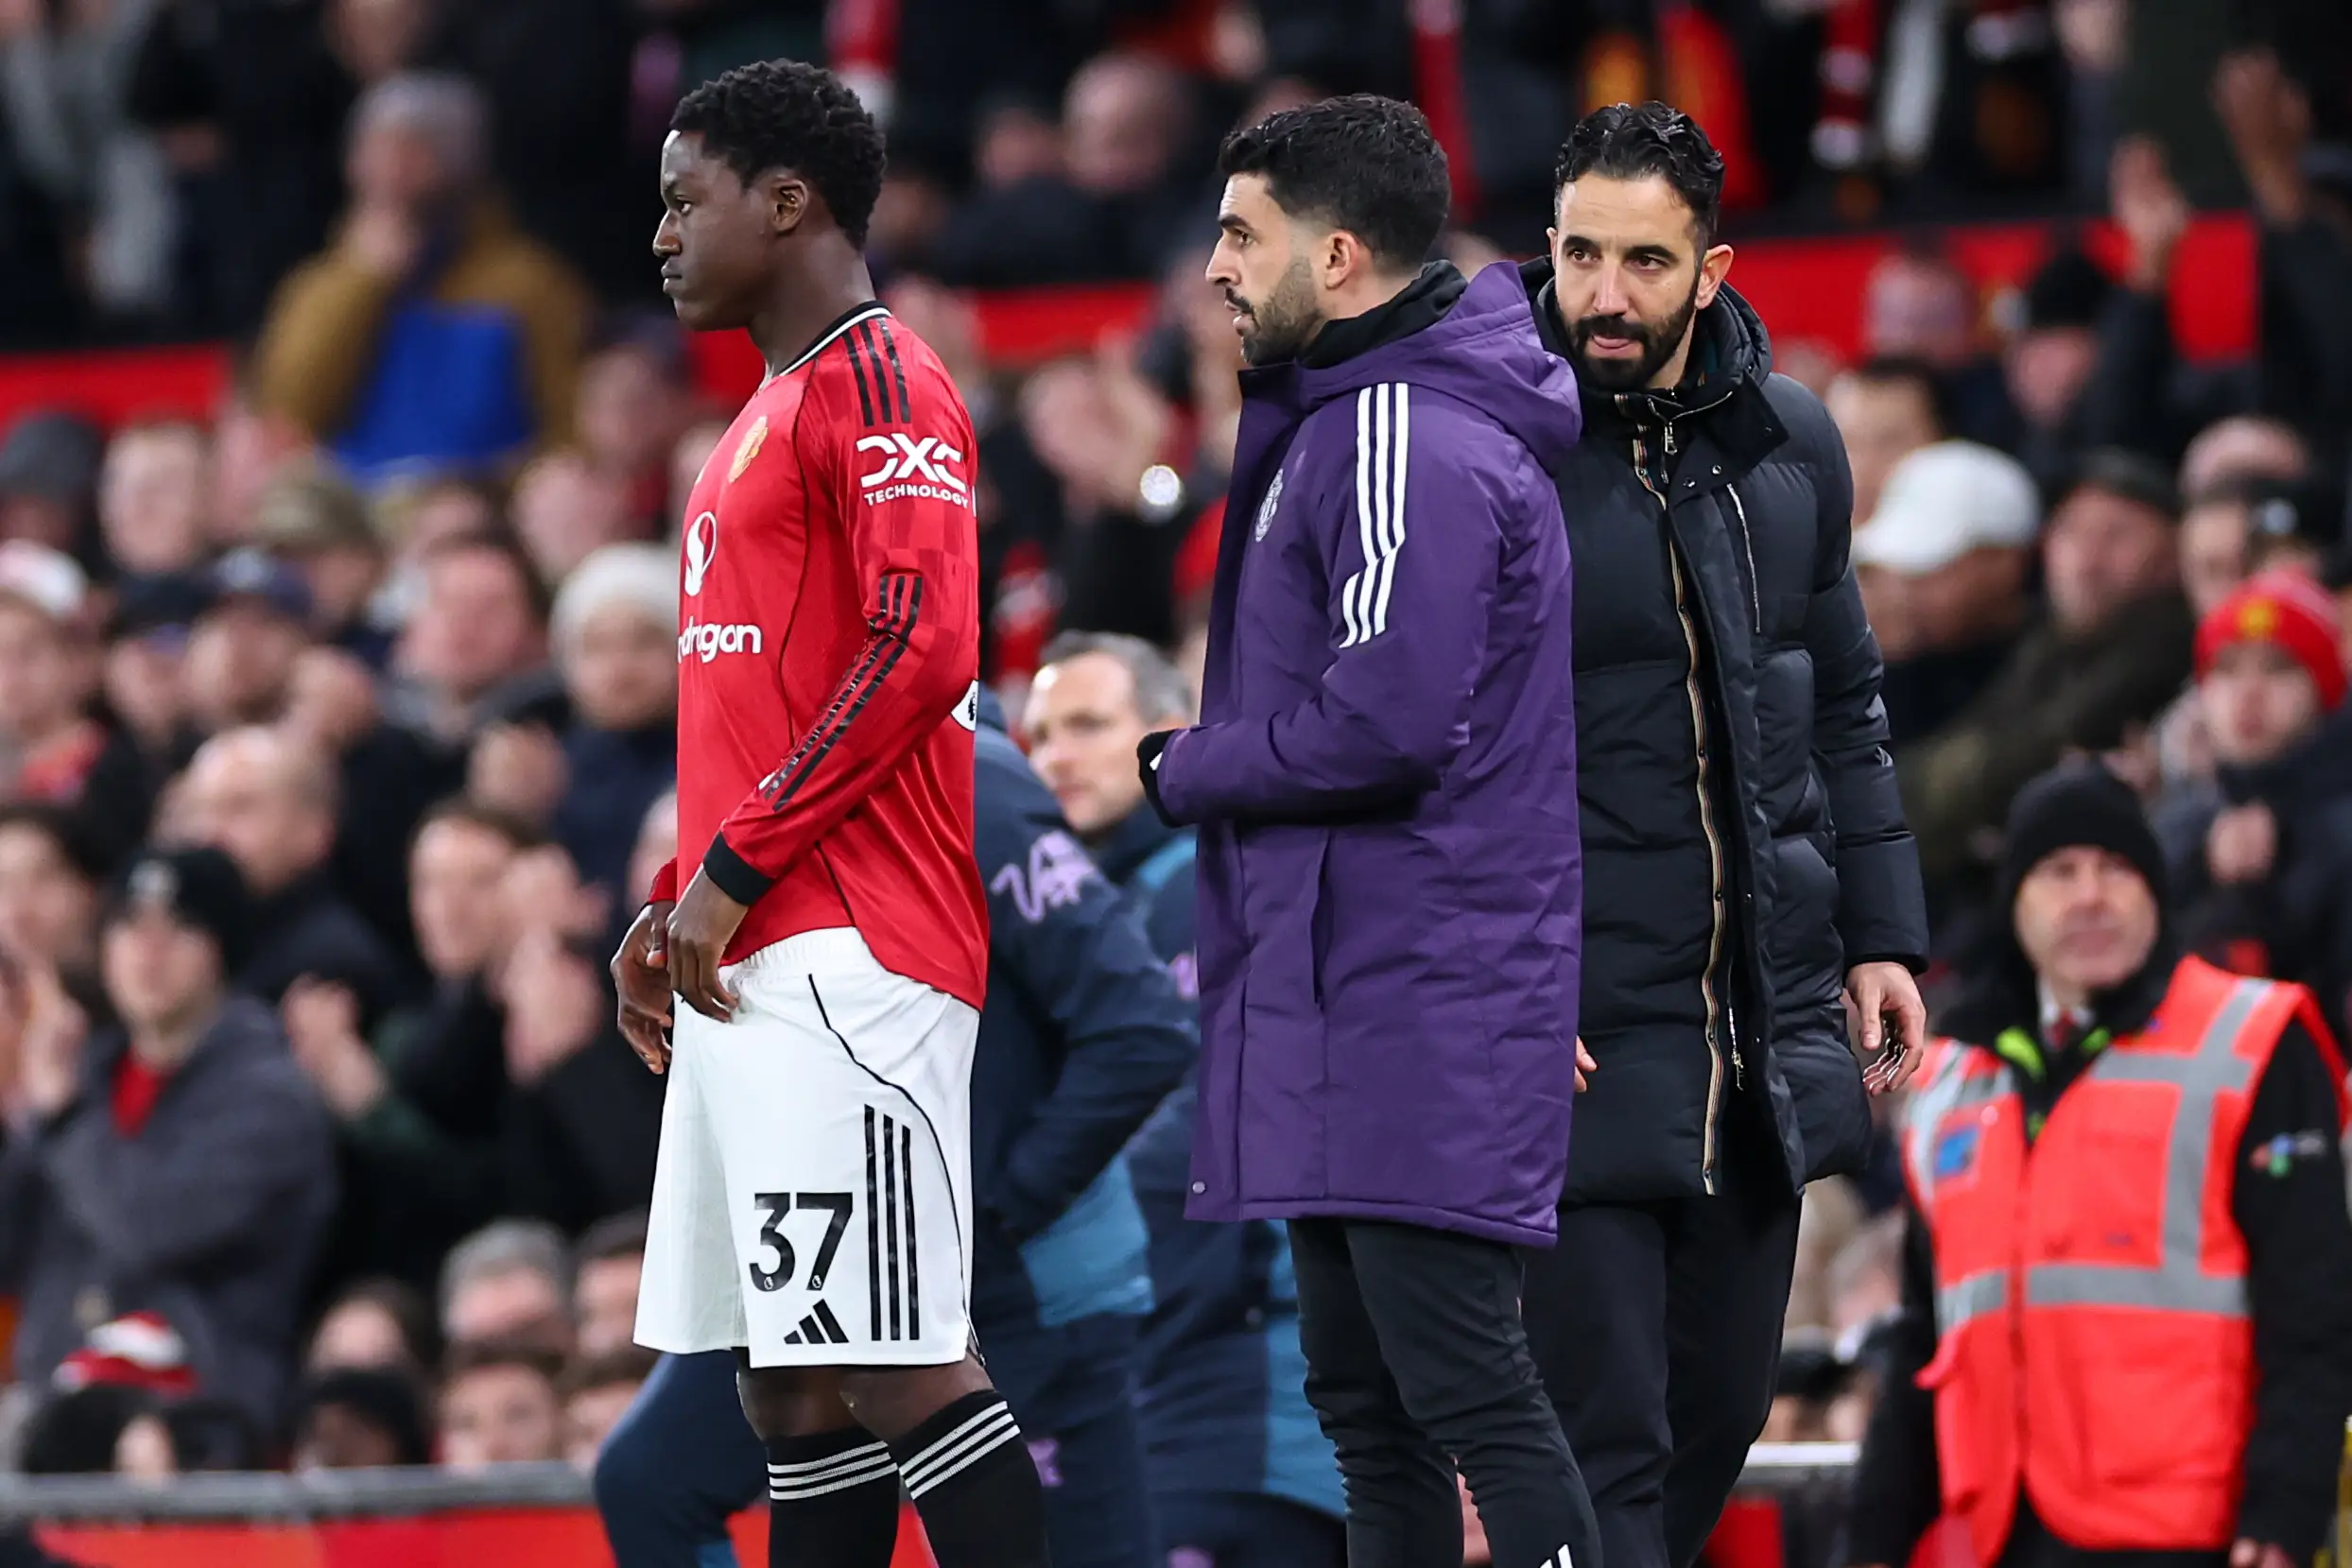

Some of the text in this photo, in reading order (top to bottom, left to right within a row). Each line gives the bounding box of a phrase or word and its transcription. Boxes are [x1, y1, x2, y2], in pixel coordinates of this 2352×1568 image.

[856, 433, 966, 493] DXC
[864, 484, 968, 508] TECHNOLOGY
[749, 1192, 853, 1292] 37
